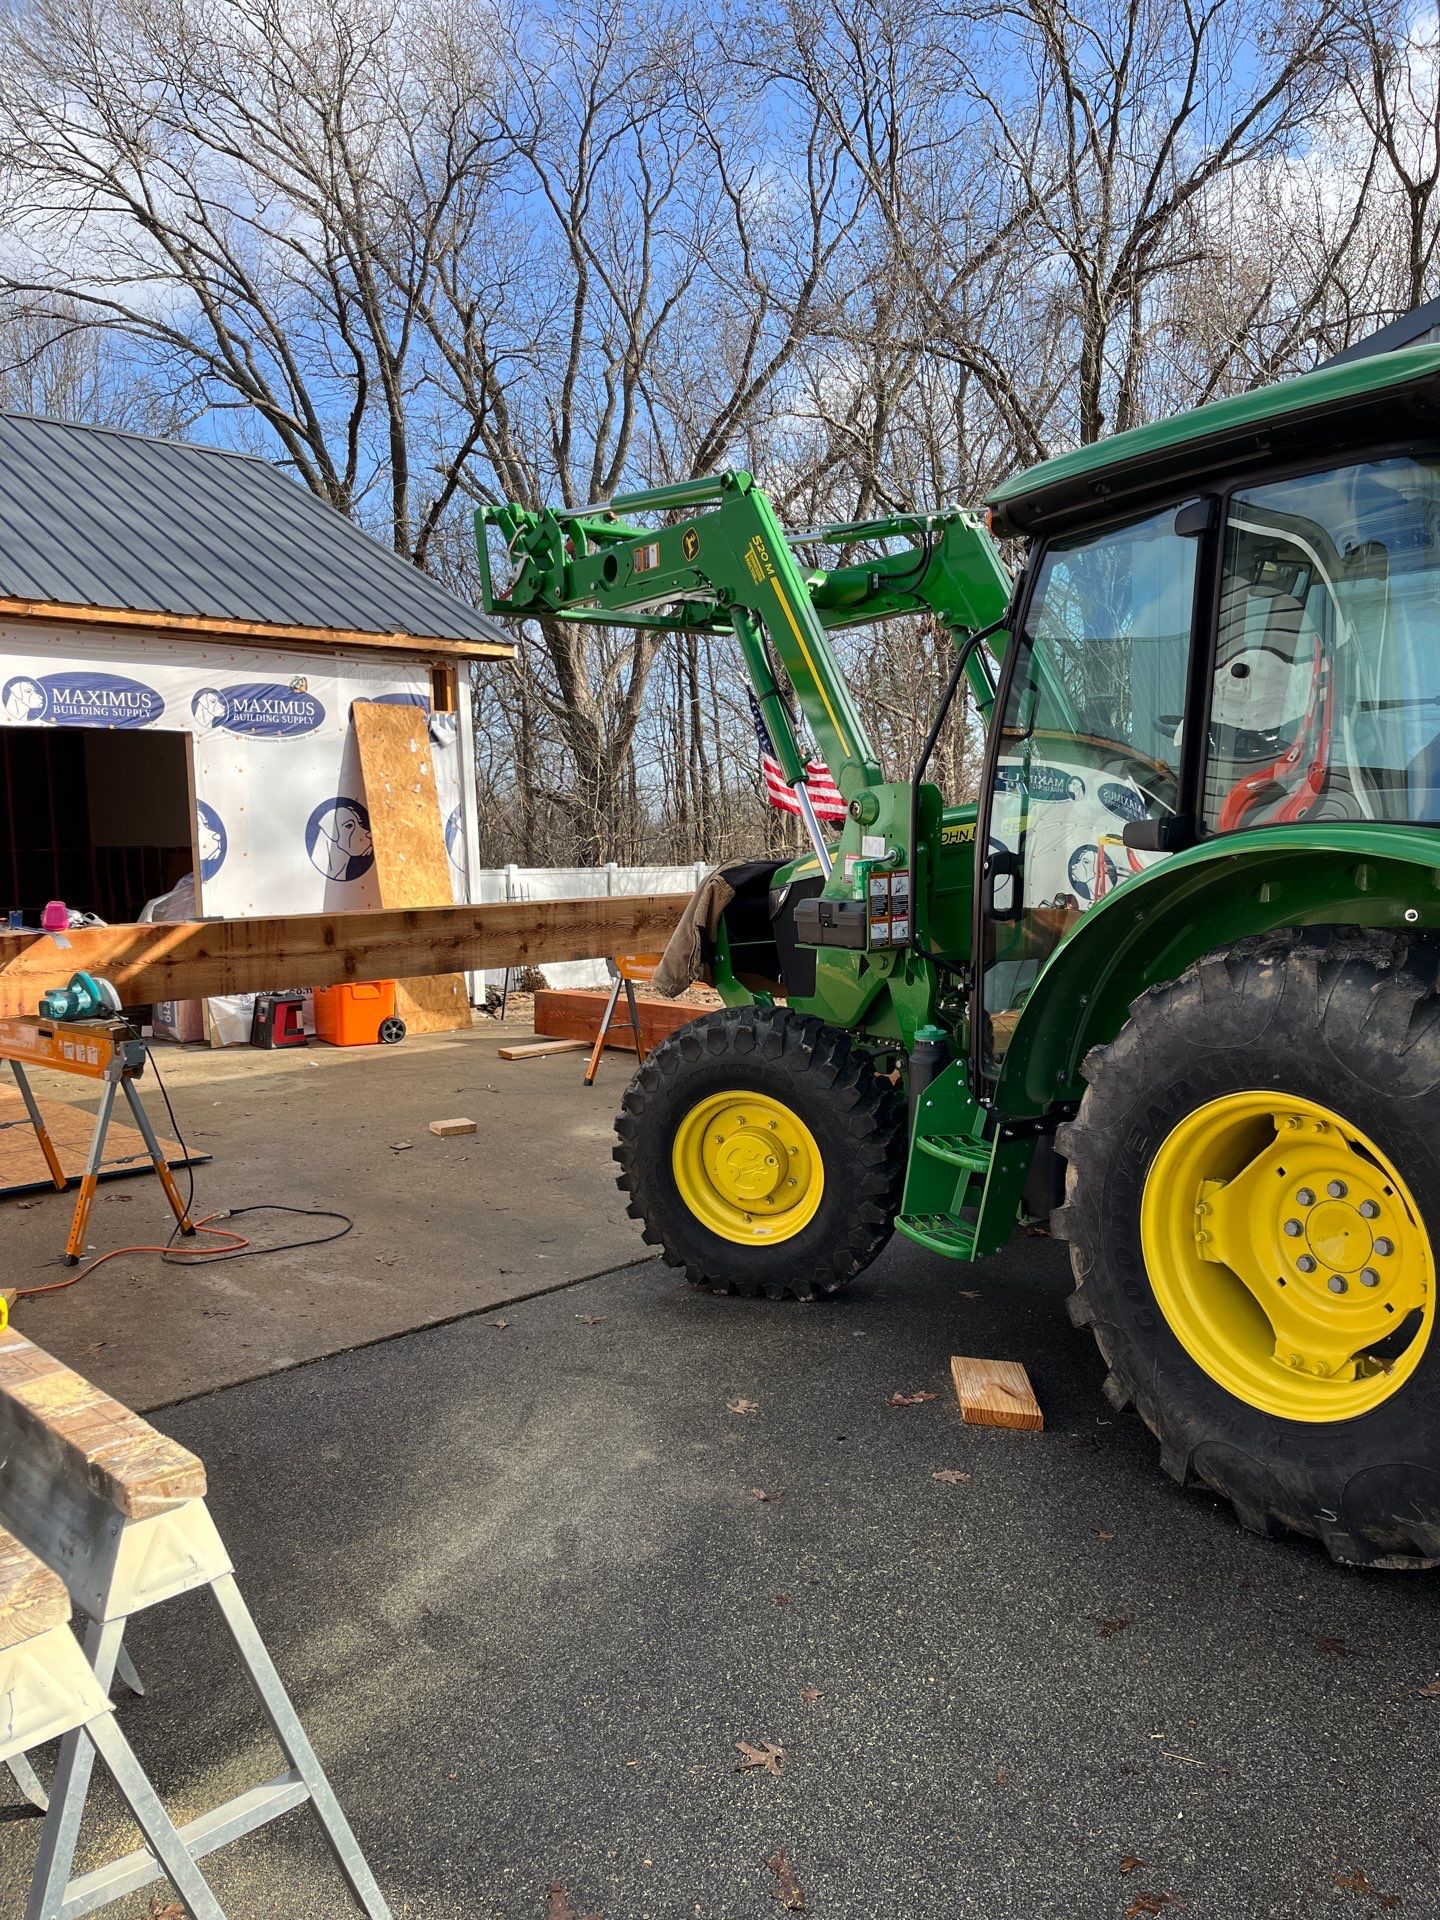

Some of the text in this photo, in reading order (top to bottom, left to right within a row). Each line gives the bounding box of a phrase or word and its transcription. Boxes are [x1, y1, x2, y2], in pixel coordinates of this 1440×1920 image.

[52, 688, 152, 708] MAXIMUS
[53, 705, 152, 718] BUILDING SUPPLY
[233, 698, 315, 716] MAXIMUS
[233, 713, 315, 725] BUILDING SUPPLY
[942, 829, 969, 845] OHN
